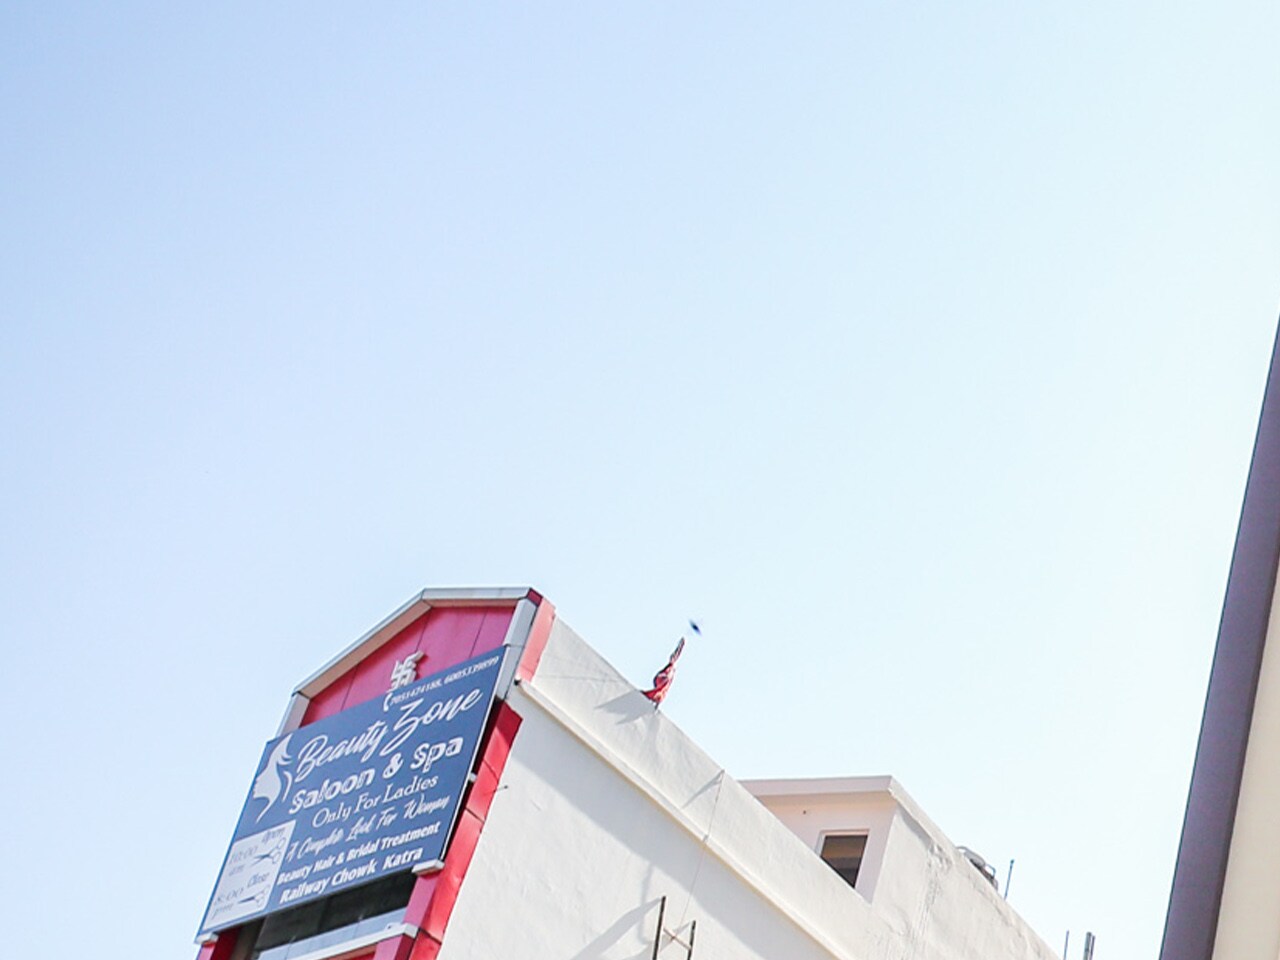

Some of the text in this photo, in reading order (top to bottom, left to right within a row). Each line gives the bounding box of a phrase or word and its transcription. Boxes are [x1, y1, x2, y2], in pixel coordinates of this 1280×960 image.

[294, 688, 484, 782] Beauty Zone
[288, 737, 464, 814] Saloon & Spa
[312, 775, 438, 828] Only For Ladies
[277, 864, 312, 886] Beauty
[313, 856, 336, 874] Hair
[380, 821, 441, 851] Treatment
[280, 848, 424, 904] Railway Chowk Katra
